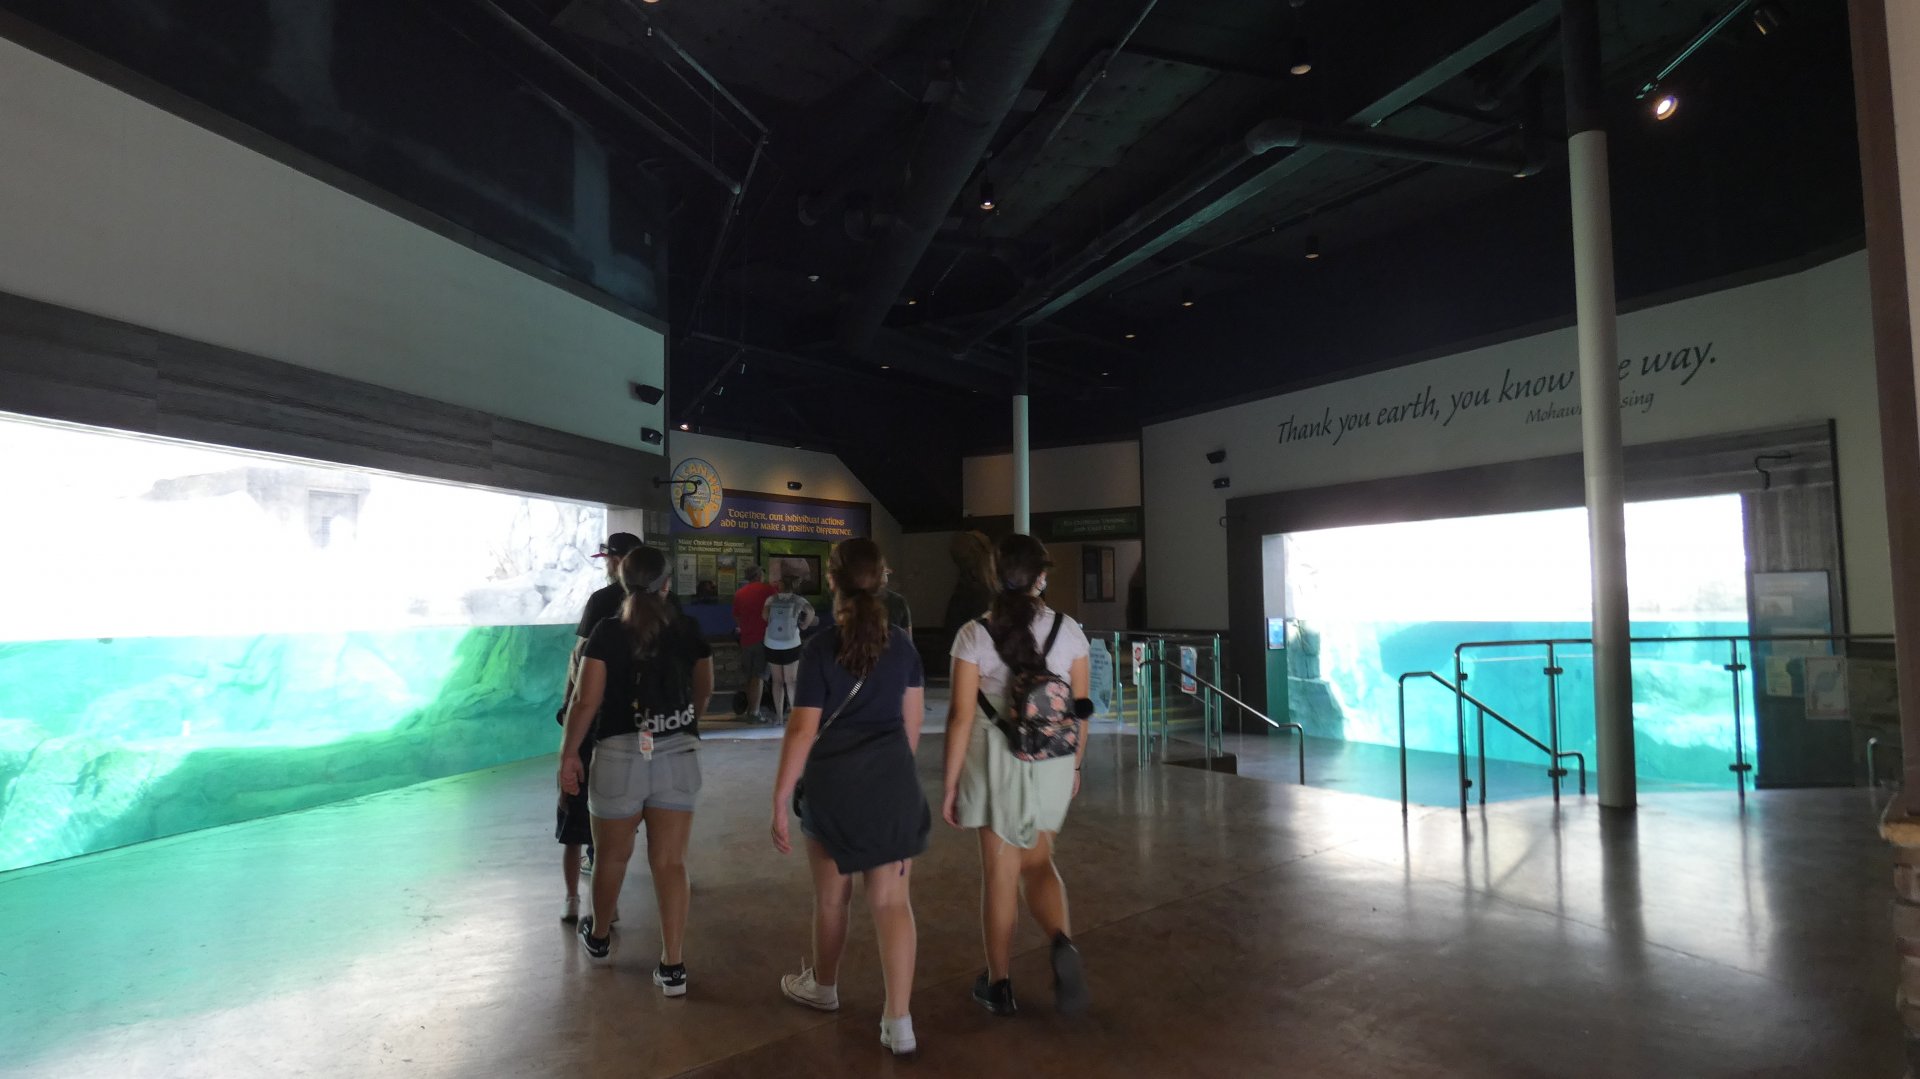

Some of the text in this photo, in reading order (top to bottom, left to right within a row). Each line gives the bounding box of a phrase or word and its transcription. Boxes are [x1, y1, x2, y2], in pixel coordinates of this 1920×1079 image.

[1277, 407, 1332, 444] Thank
[1333, 412, 1371, 445] you
[1377, 385, 1440, 426] earth,
[1443, 388, 1491, 427] you
[1498, 368, 1574, 403] know
[1641, 342, 1716, 386] way.
[1525, 401, 1582, 424] Mohaw
